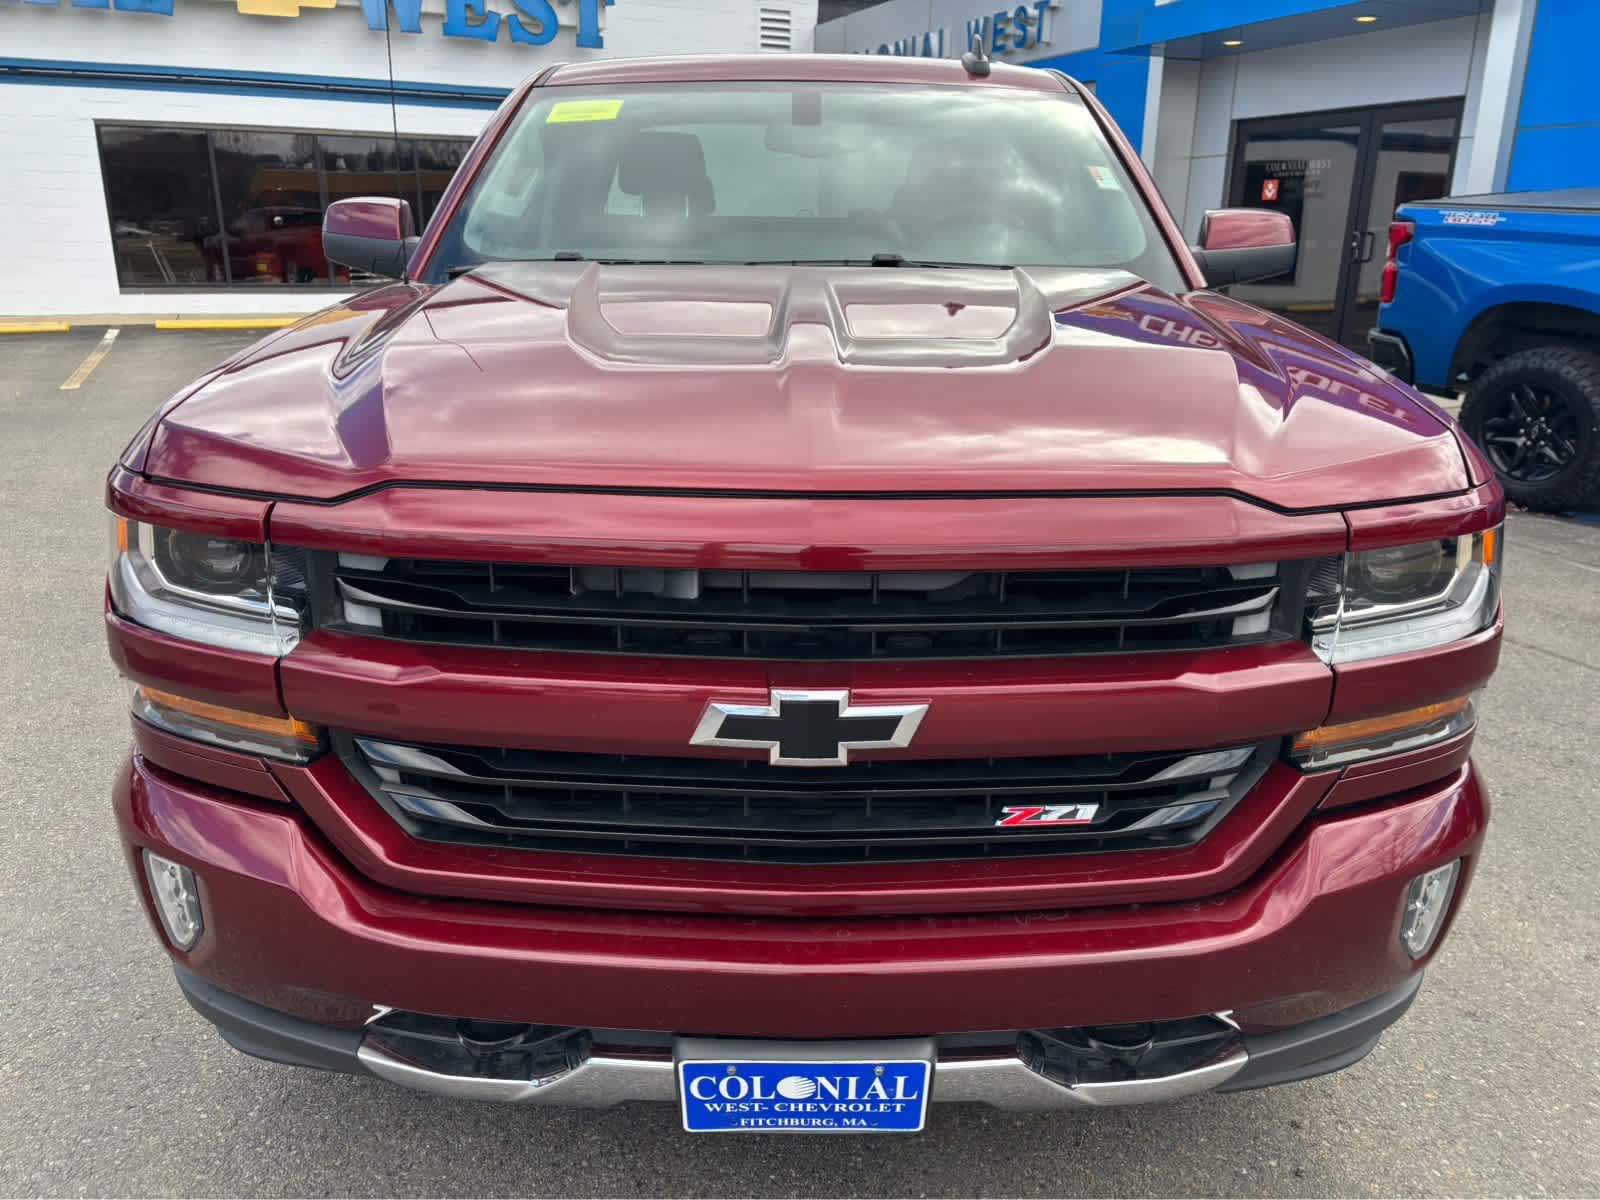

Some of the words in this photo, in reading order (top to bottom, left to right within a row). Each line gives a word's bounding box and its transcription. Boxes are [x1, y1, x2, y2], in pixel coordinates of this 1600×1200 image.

[966, 0, 1050, 57] WEST
[994, 803, 1100, 828] Z71
[689, 1074, 919, 1101] COLONIAL
[774, 1102, 906, 1113] CHEVROLET
[842, 1118, 868, 1127] MA
